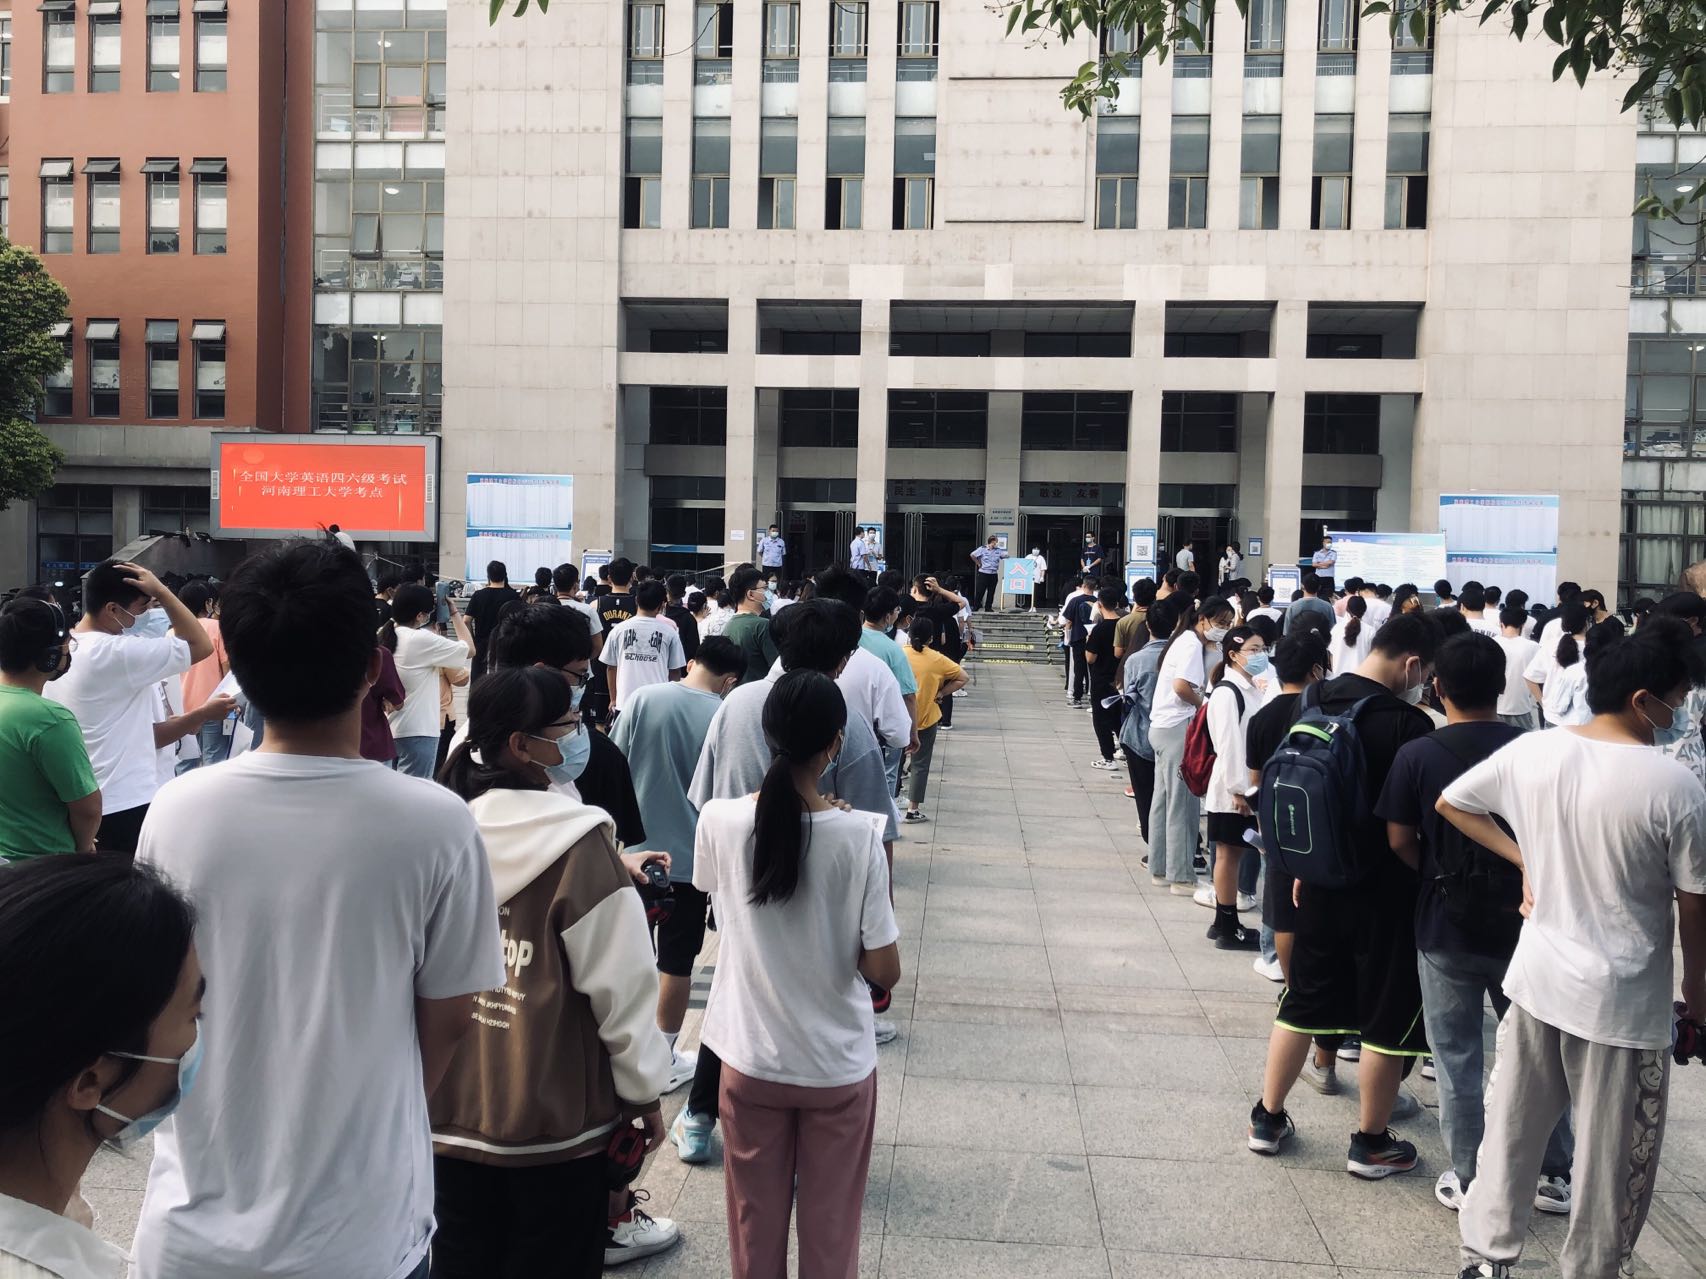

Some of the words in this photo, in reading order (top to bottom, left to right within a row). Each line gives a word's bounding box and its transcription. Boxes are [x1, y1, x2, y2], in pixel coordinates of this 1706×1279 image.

[240, 471, 408, 485] 全国大学英语四六级考试
[261, 485, 384, 498] 河南理工大学考点
[1009, 563, 1028, 590] 入口
